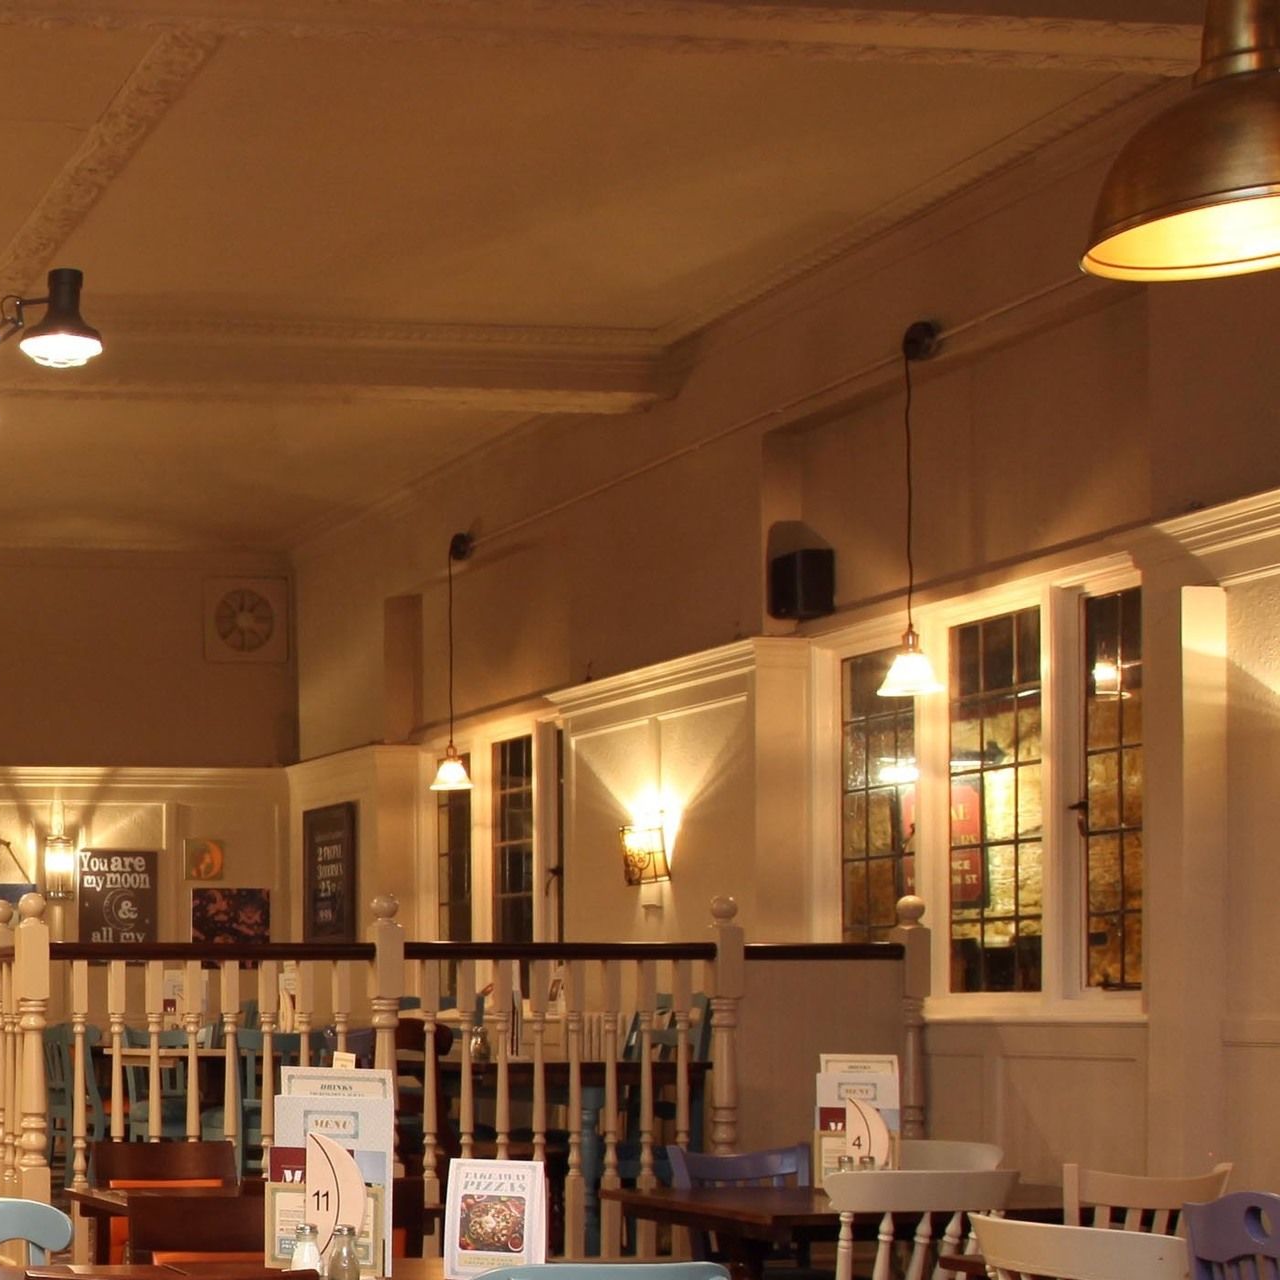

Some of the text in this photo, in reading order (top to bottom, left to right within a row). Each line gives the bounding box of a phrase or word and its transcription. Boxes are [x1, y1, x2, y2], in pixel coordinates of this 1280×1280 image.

[79, 852, 146, 871] You are
[83, 872, 151, 892] my moon
[118, 900, 138, 919] &
[91, 927, 113, 943] all
[313, 1119, 352, 1130] MENU
[852, 1136, 862, 1150] 4
[463, 1181, 527, 1192] PIZZAS
[312, 1190, 329, 1211] 11
